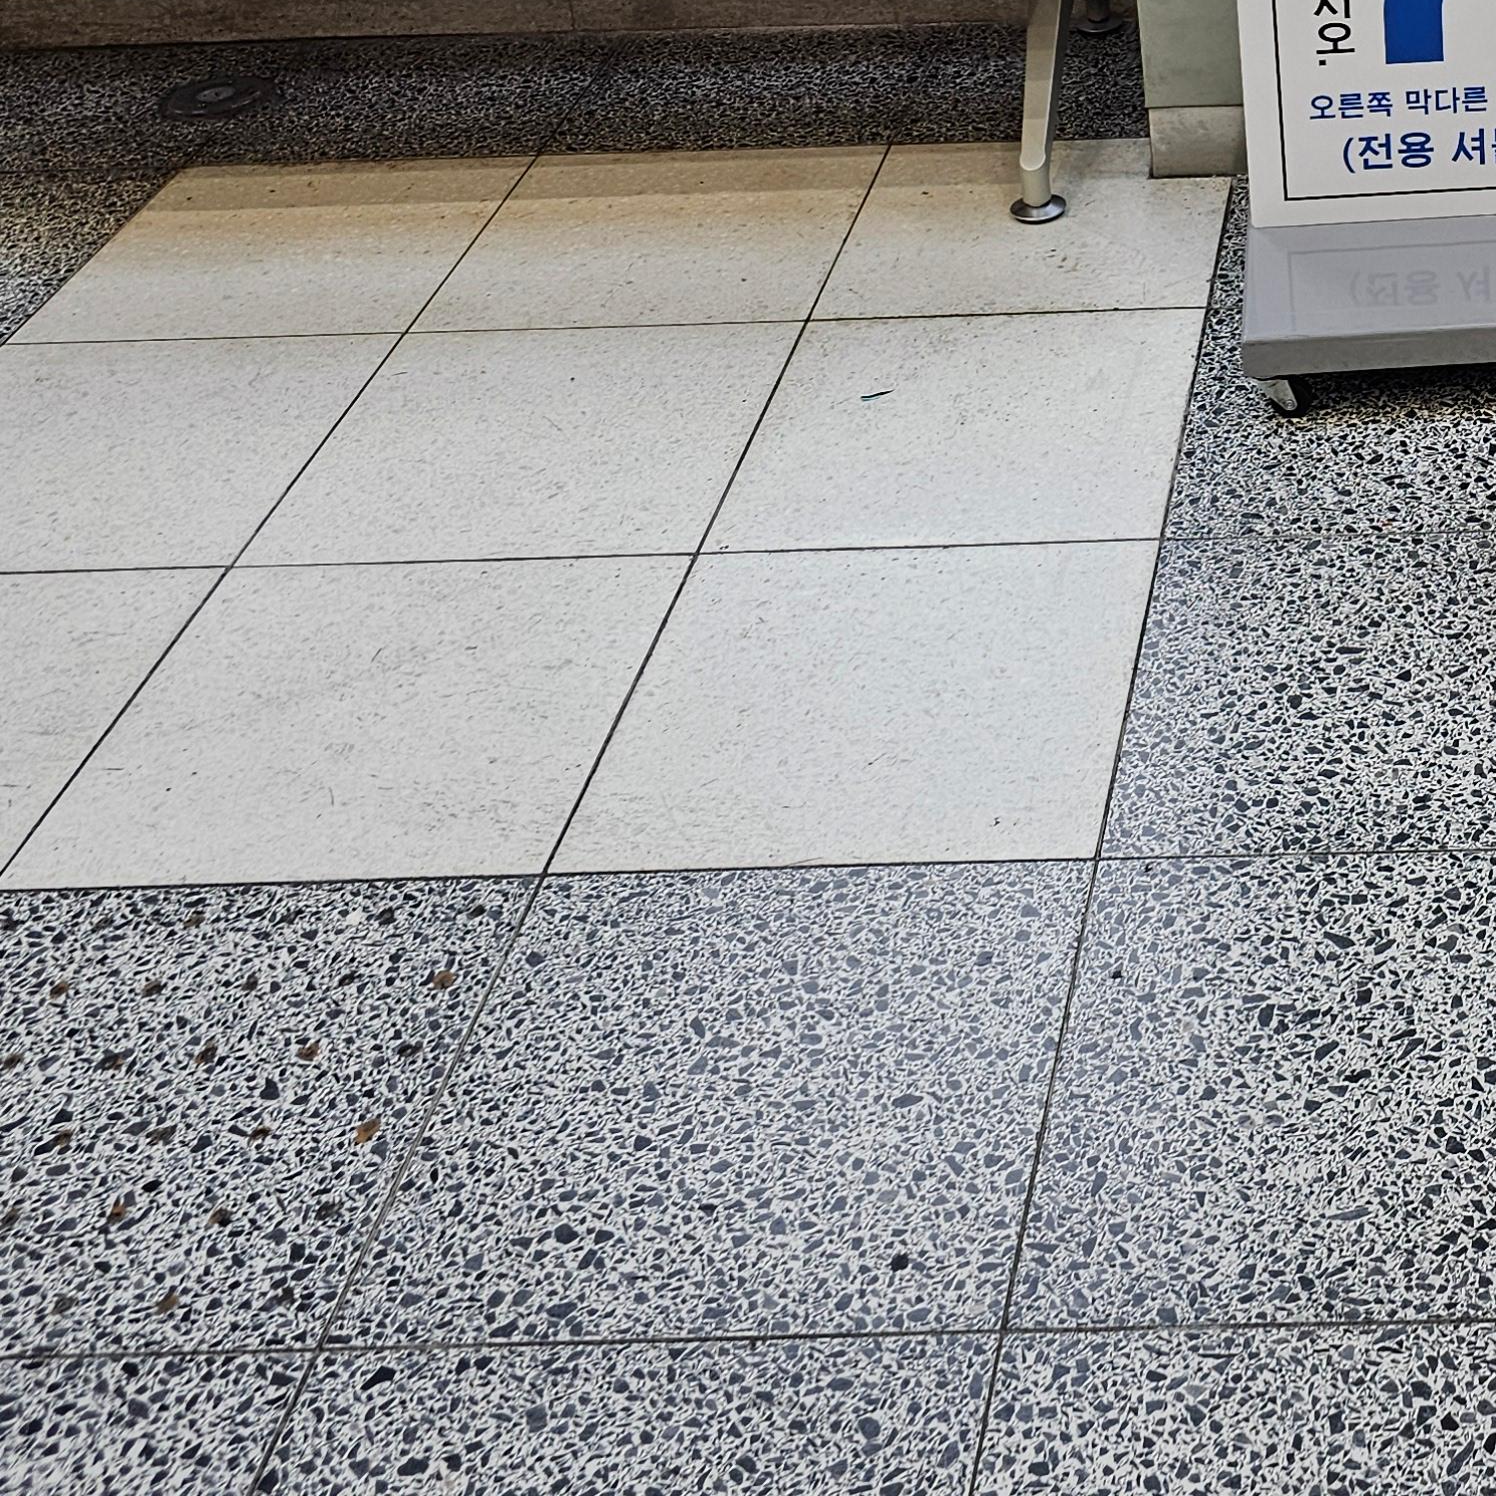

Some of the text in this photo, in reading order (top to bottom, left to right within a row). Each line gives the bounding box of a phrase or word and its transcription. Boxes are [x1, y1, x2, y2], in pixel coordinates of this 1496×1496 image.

[1308, 90, 1394, 121] 오른쪽
[1404, 85, 1489, 116] 막다른
[1341, 128, 1436, 174] (전용
